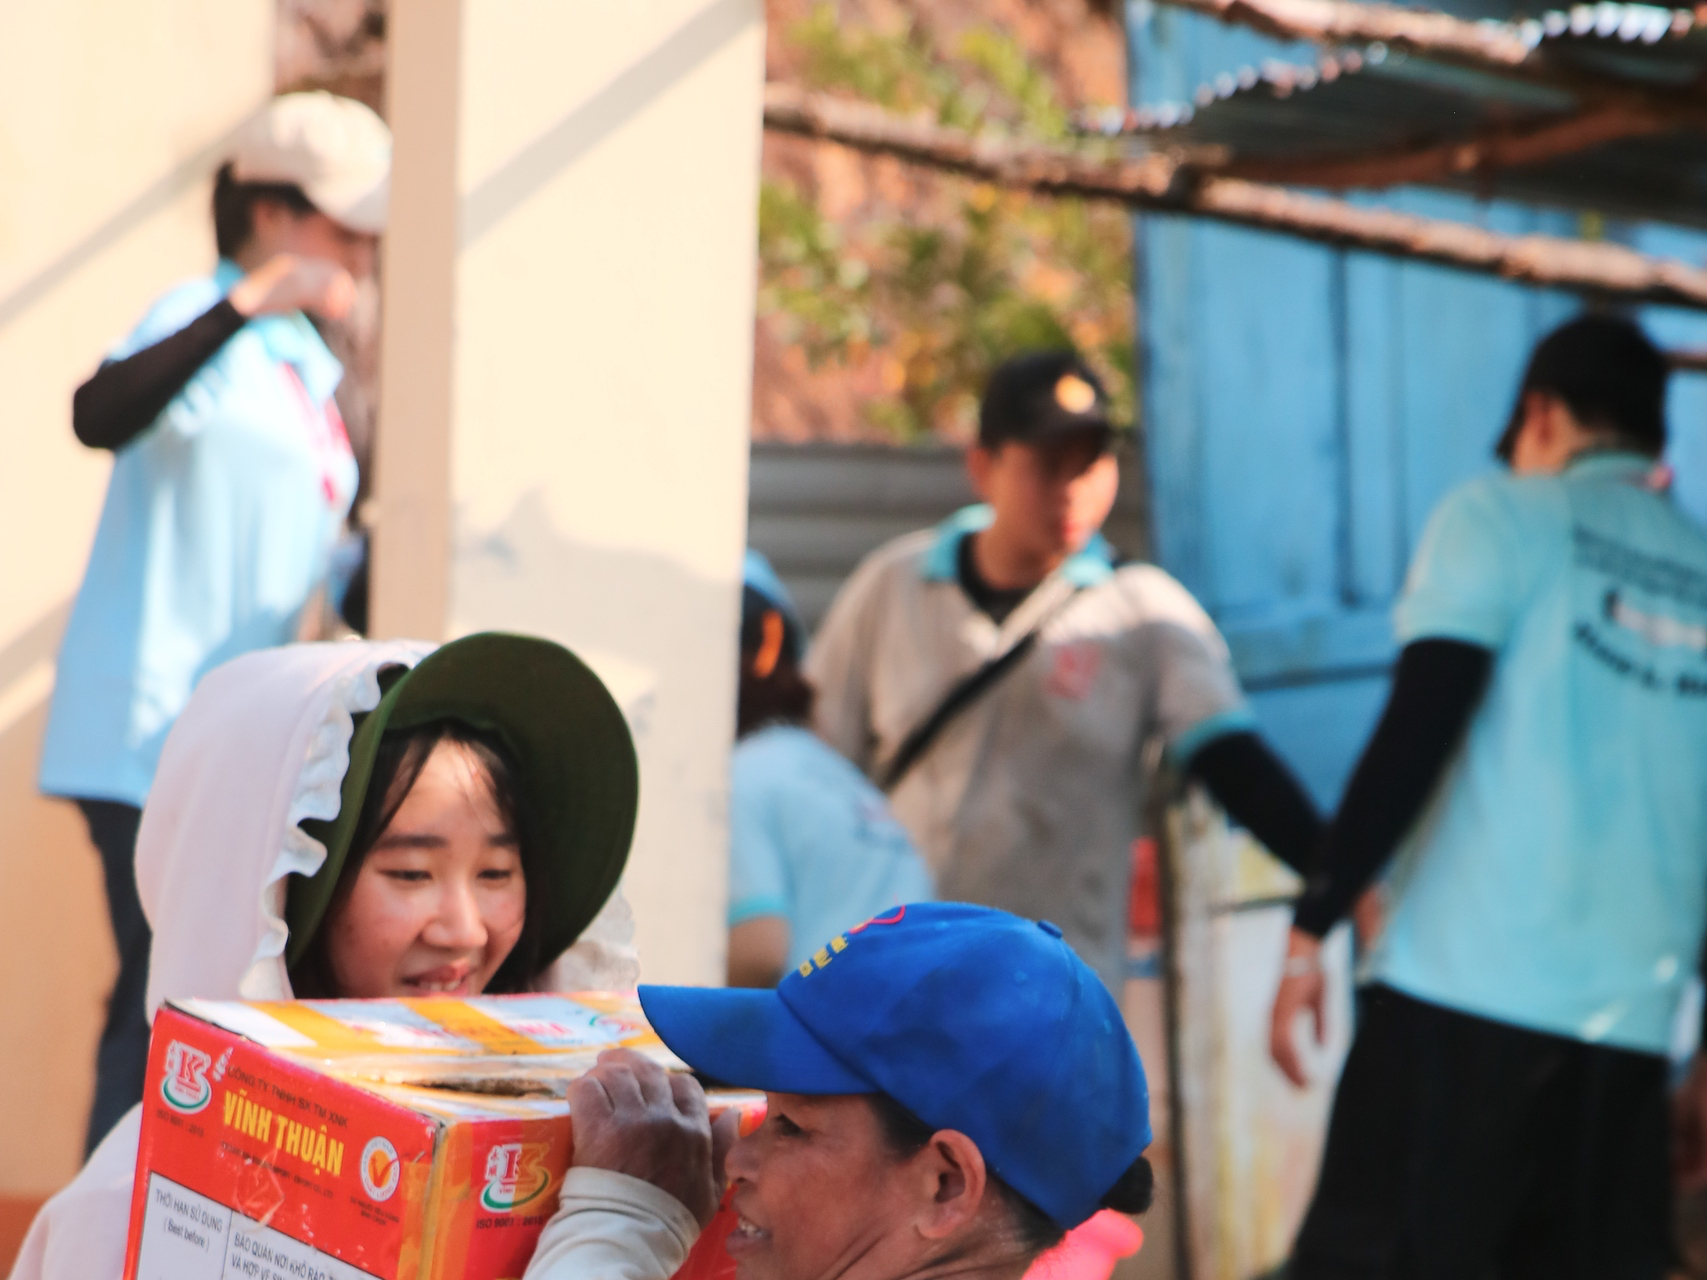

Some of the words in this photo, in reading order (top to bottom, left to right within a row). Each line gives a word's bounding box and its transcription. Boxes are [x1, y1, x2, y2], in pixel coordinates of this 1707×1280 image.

[228, 1063, 255, 1087] CÔNG
[258, 1078, 270, 1094] TY
[313, 1101, 326, 1119] TM
[328, 1108, 348, 1129] XNK
[223, 1088, 273, 1143] VĨNH
[275, 1114, 345, 1176] THUẬN
[476, 1218, 493, 1231] ISO
